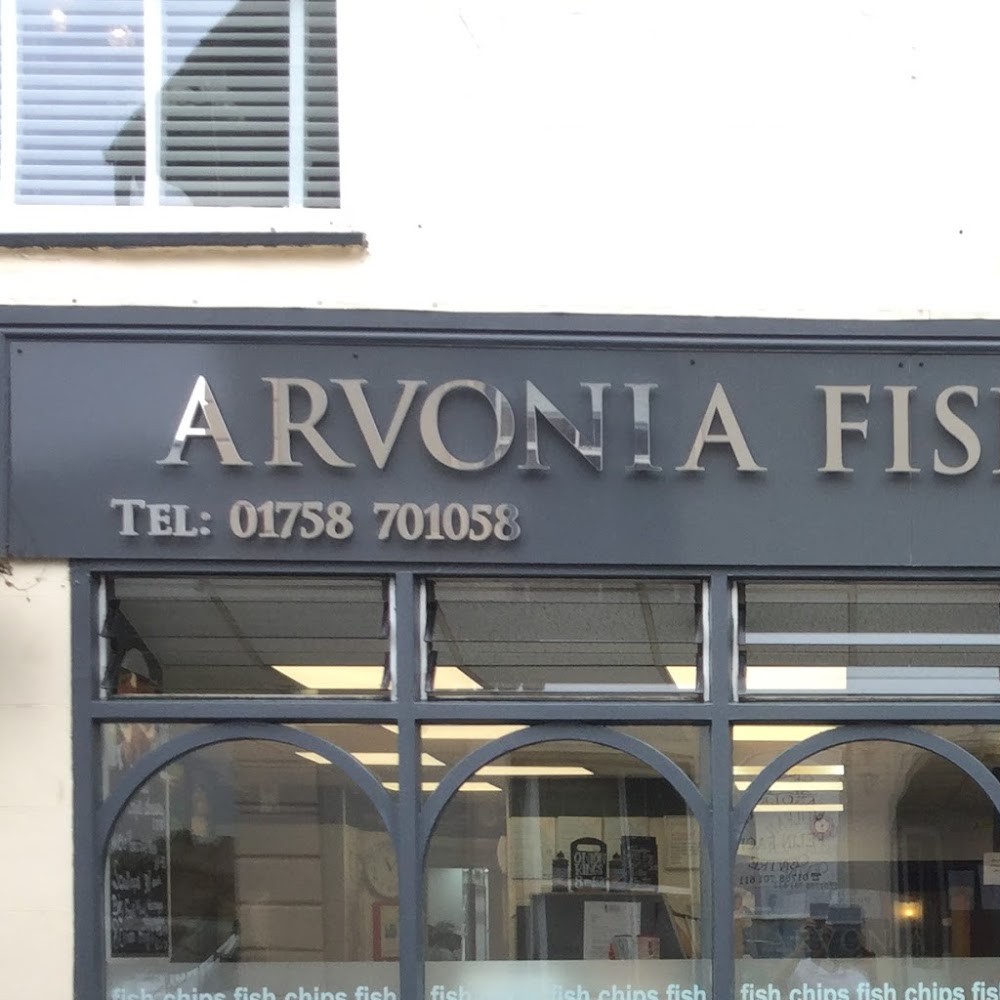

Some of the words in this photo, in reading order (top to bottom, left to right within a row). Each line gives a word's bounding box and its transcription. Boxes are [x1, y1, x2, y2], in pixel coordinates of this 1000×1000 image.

[156, 375, 768, 474] ARVONIA
[110, 498, 211, 538] TEL:
[229, 500, 354, 542] 01758
[373, 501, 522, 544] 701058
